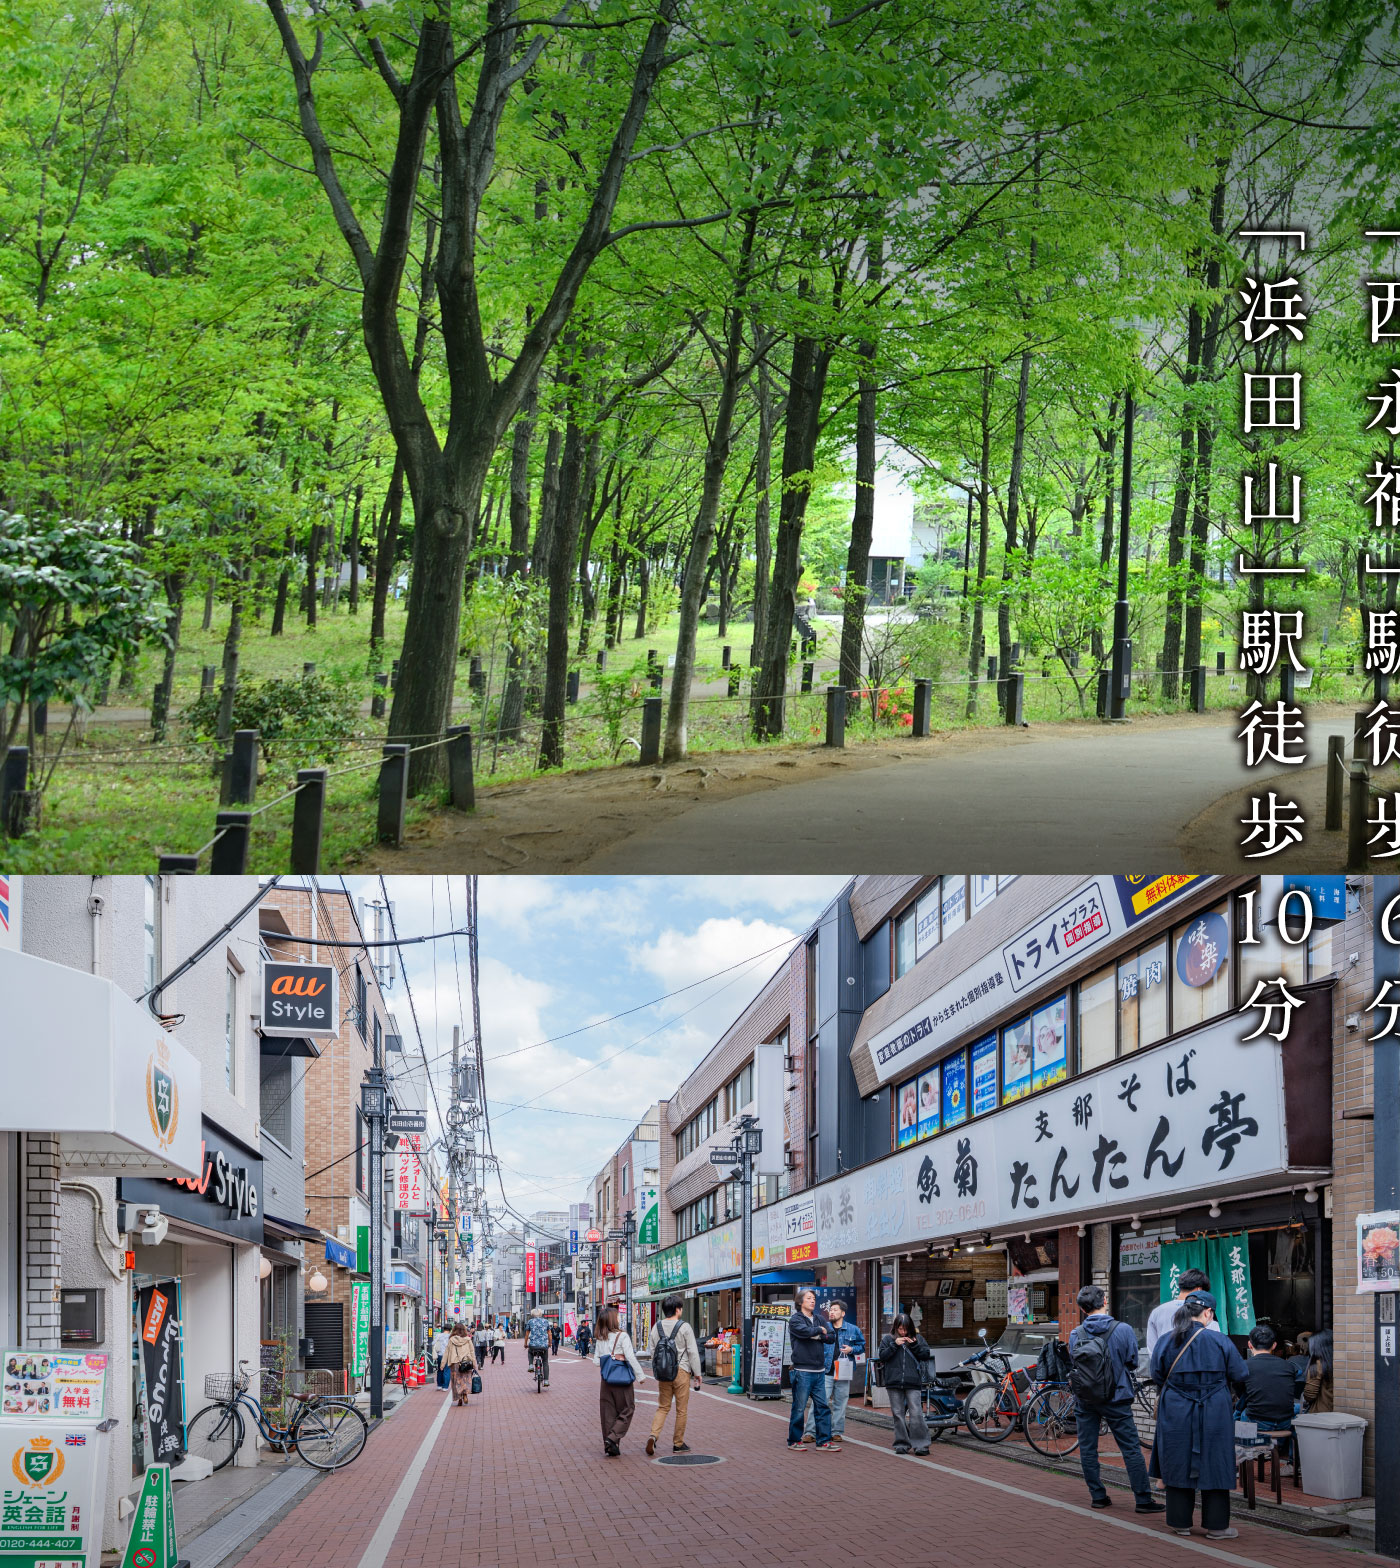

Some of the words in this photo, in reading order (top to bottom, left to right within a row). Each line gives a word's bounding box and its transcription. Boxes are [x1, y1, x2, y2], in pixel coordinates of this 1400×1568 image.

[1064, 911, 1103, 948] 個別指導
[1010, 923, 1060, 980] トライ
[1188, 919, 1218, 971] 味楽
[270, 975, 327, 998] au
[1120, 961, 1163, 1001] 焼肉
[271, 1000, 326, 1021] Style
[877, 1016, 933, 1065] 家庭教師のトライ
[933, 971, 1004, 1027] から生まれた個別指導塾
[1033, 1049, 1198, 1143] 支那そば
[1009, 1090, 1260, 1210] たんたん亭
[215, 1150, 258, 1220] Style
[398, 1137, 409, 1208] 靴、バッグ修理の店
[786, 1216, 802, 1235] トライ
[916, 1213, 933, 1231] TEL
[1228, 1245, 1249, 1321] 支那そば
[1380, 1267, 1394, 1278] 50
[55, 1367, 104, 1377] キャンペーン
[62, 1395, 91, 1409] 無料
[65, 1386, 90, 1395] 入学金
[3, 1490, 68, 1505] シェーン
[2, 1505, 67, 1523] 英会話
[70, 1506, 81, 1532] 月謝制
[140, 1495, 159, 1543] 駐輪禁止
[0, 1539, 76, 1548] 0120-444-407
